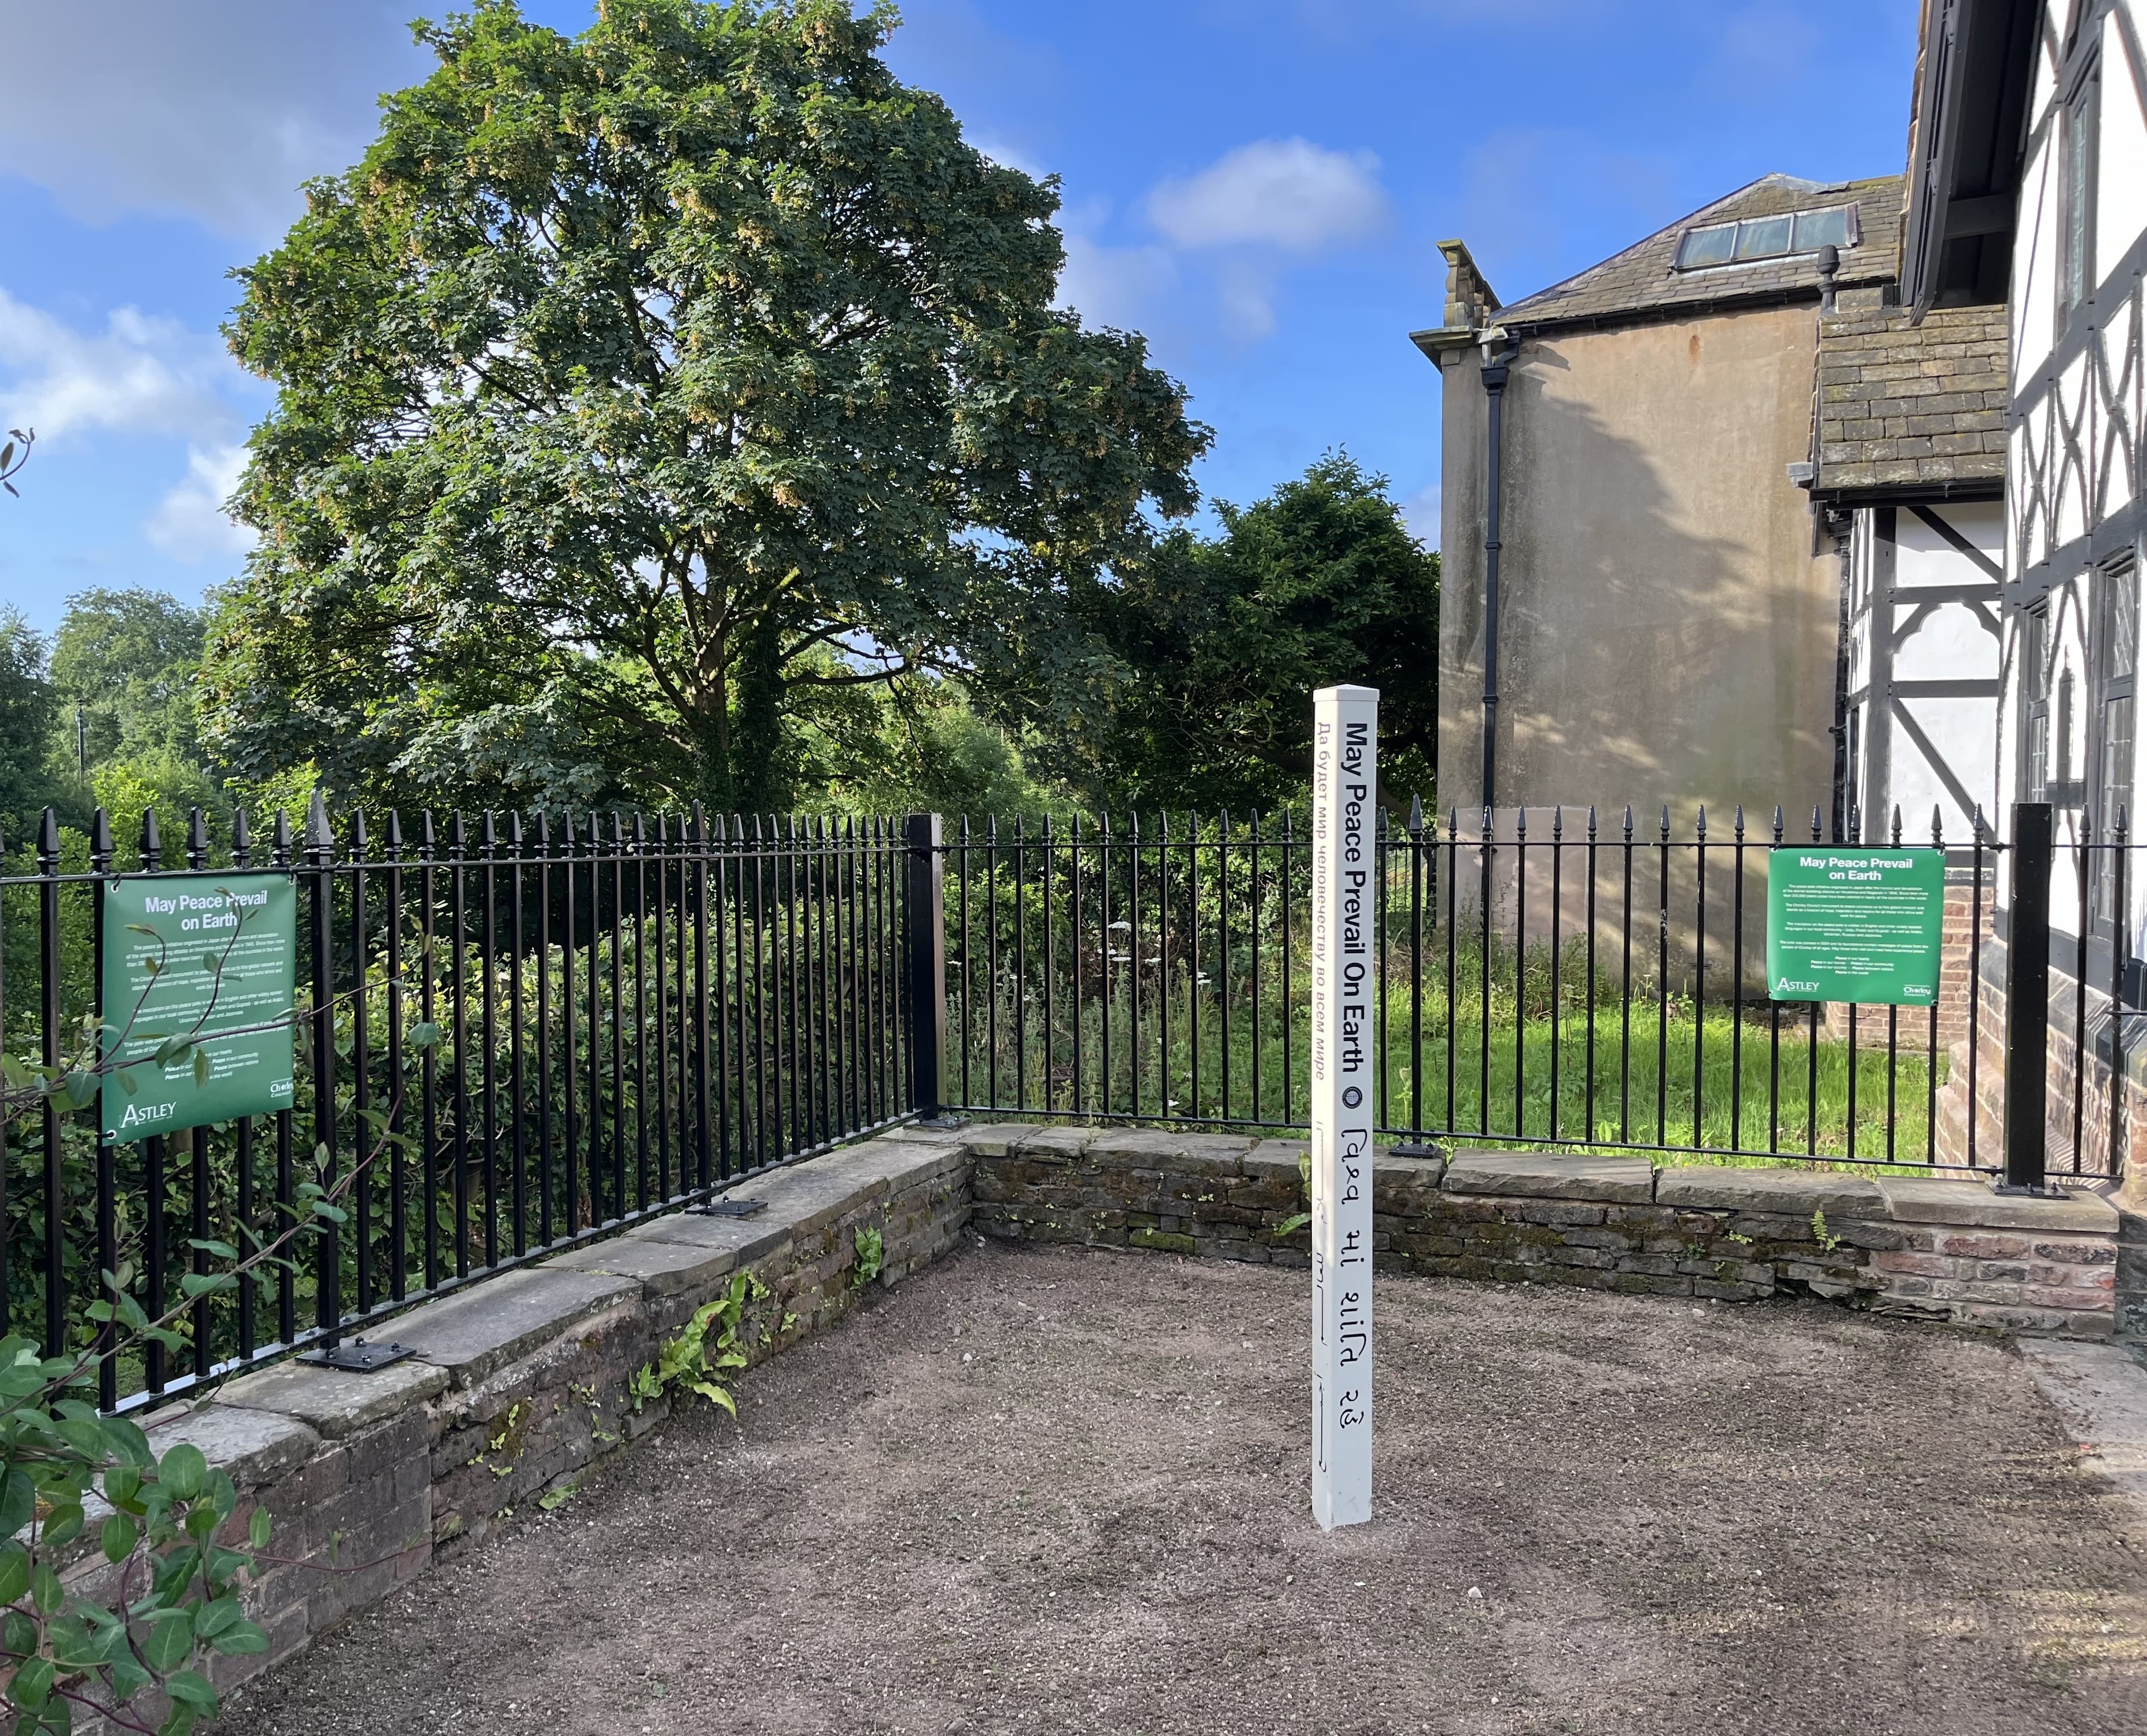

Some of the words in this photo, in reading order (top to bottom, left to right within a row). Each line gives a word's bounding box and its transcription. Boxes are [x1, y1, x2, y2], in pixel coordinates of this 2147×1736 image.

[1318, 722, 1330, 746] Да
[1341, 723, 1367, 776] May
[1317, 750, 1330, 801] будет
[1317, 807, 1326, 839] мир
[1345, 785, 1366, 863] Peace
[1800, 857, 1826, 869] May
[1829, 858, 1867, 867] Peace
[1870, 858, 1913, 868] Prevail
[1829, 871, 1845, 880] on
[1848, 870, 1881, 880] Earth
[145, 896, 176, 914] May
[179, 895, 222, 910] Peace
[1316, 845, 1327, 961] человечеству
[1344, 870, 1366, 954] Prevail
[181, 918, 199, 930] on
[203, 912, 237, 928] Earth
[1317, 968, 1326, 987] во
[1344, 962, 1365, 996] On
[1777, 977, 1819, 991] ASTLEY
[1317, 992, 1325, 1032] всем
[1343, 1005, 1364, 1072] Earth
[1315, 1038, 1325, 1080] мире
[120, 1102, 177, 1128] ASTLEY
